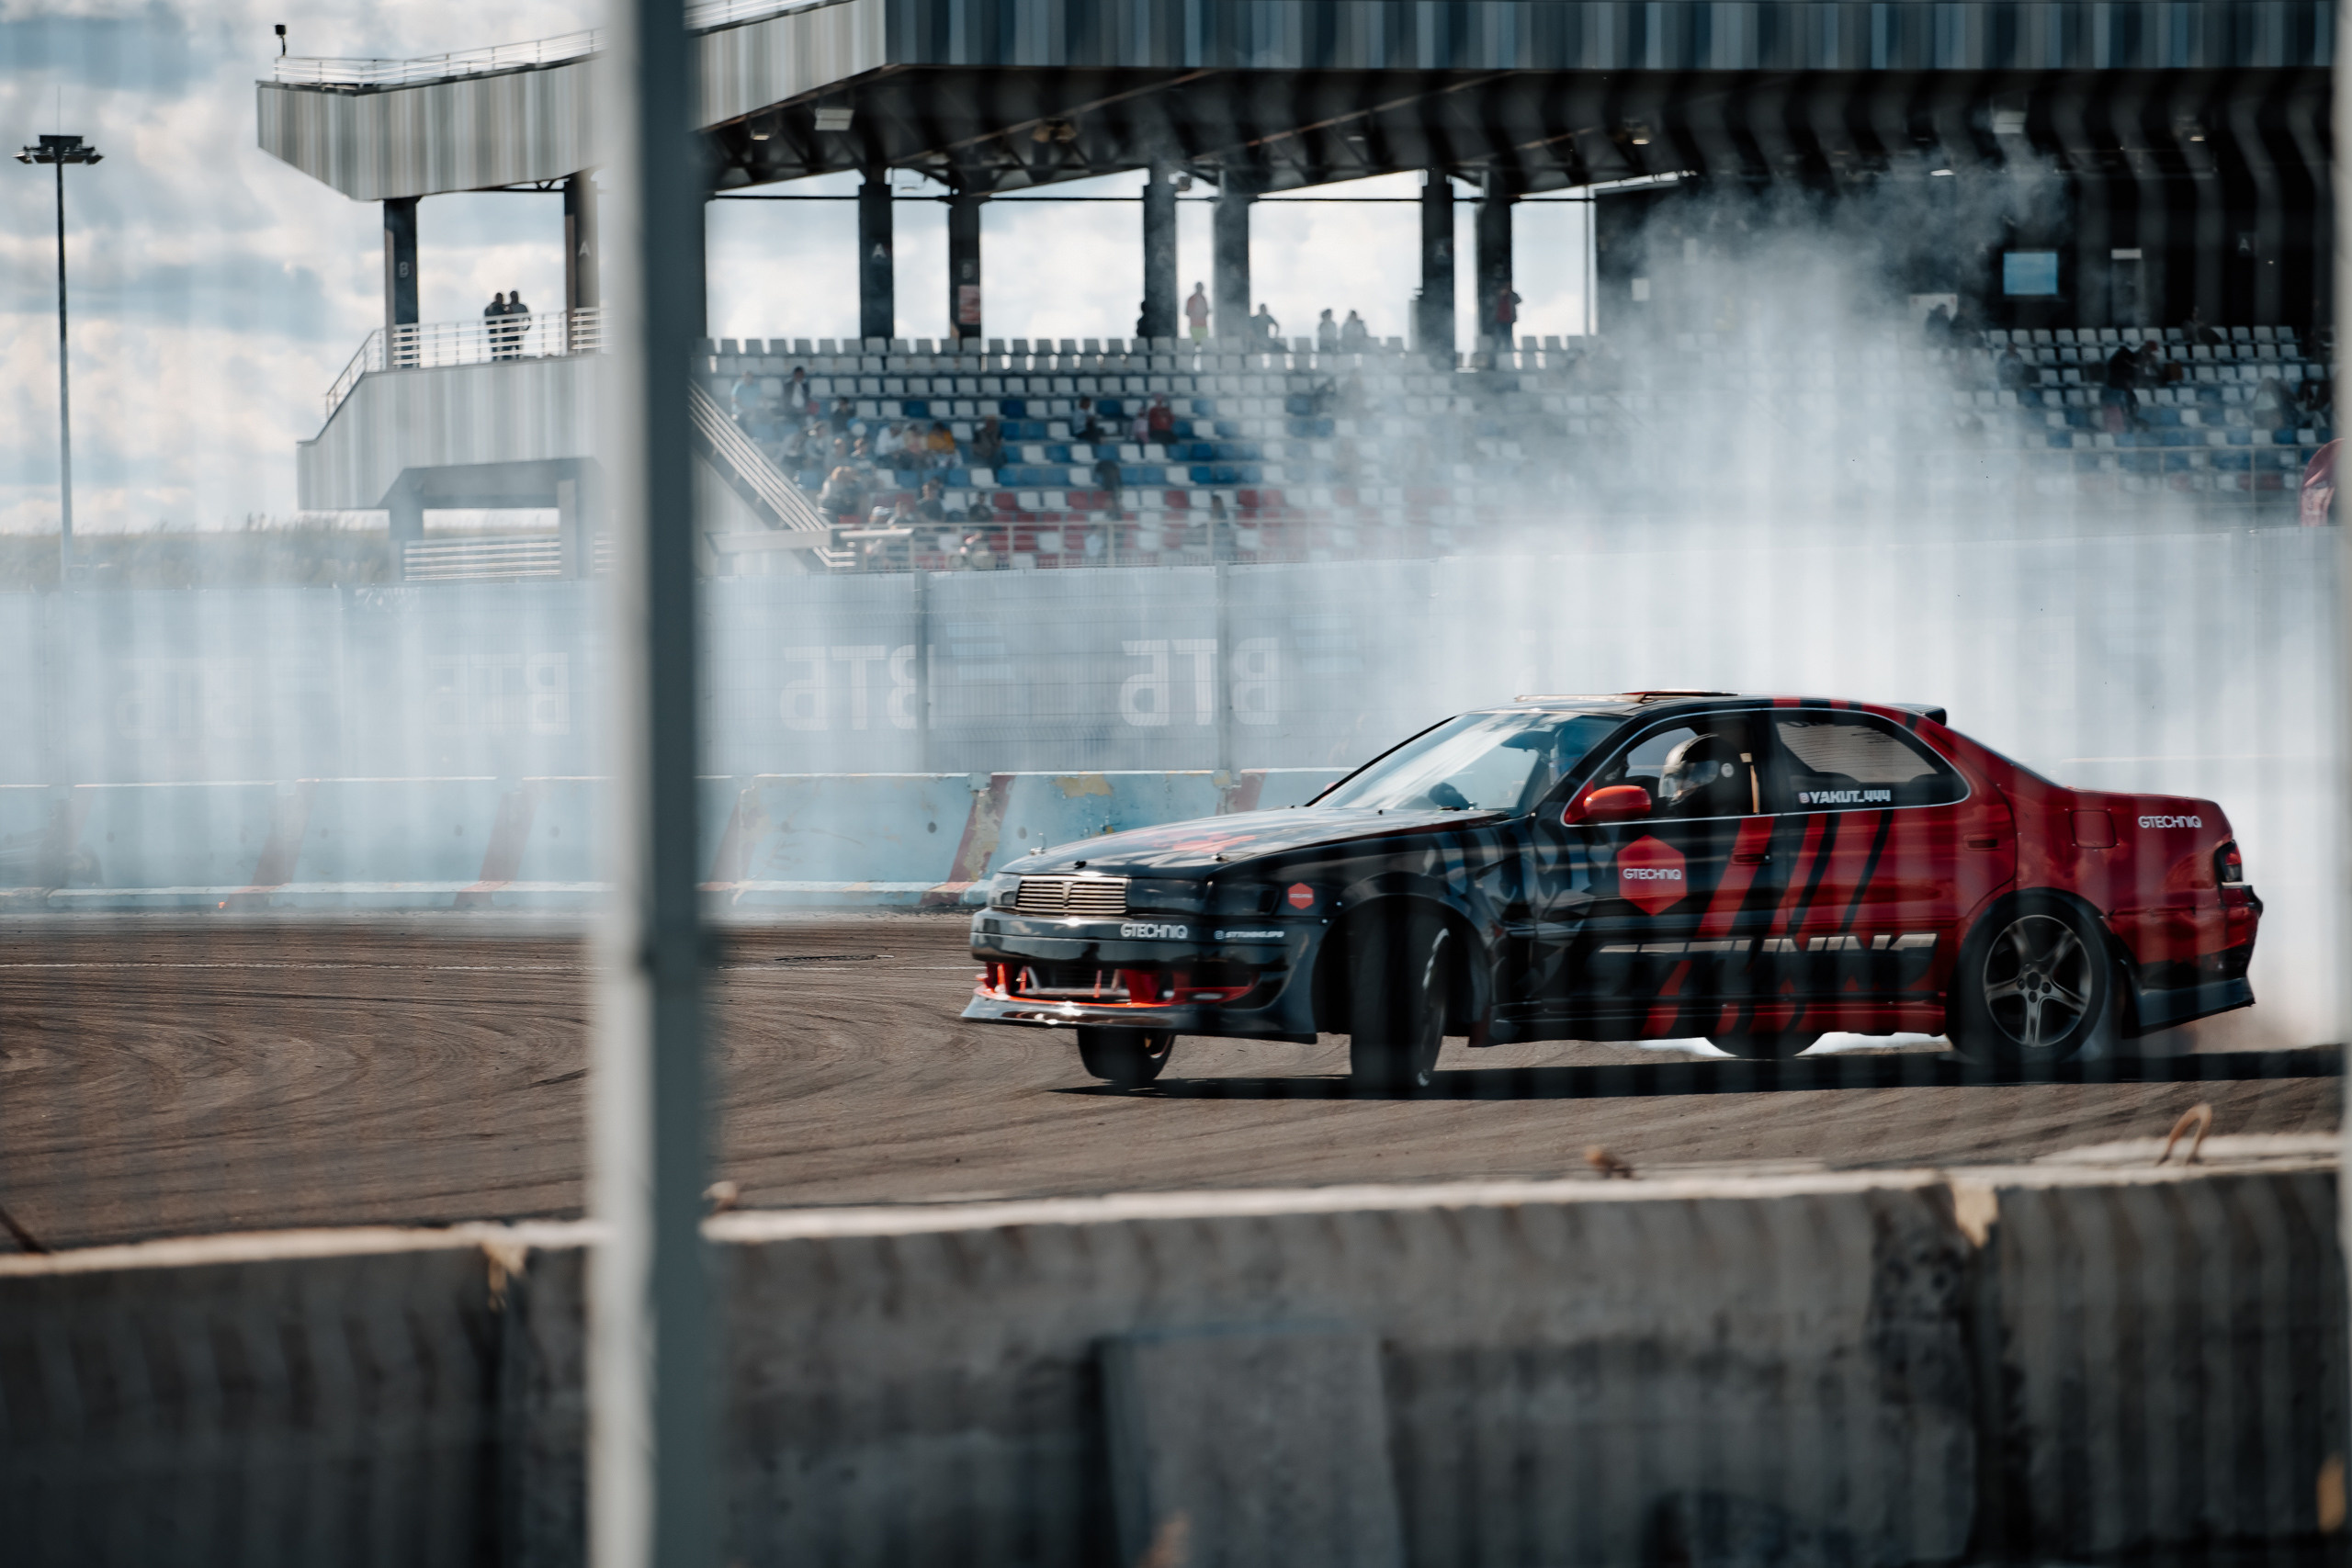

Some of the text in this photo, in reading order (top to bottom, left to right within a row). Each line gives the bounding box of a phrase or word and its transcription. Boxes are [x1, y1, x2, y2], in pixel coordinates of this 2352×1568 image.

[872, 243, 887, 258] A
[2137, 815, 2203, 829] GTECHNIQ
[1623, 868, 1682, 880] GTECHNIQ
[1120, 923, 1189, 939] GTECHNIQ
